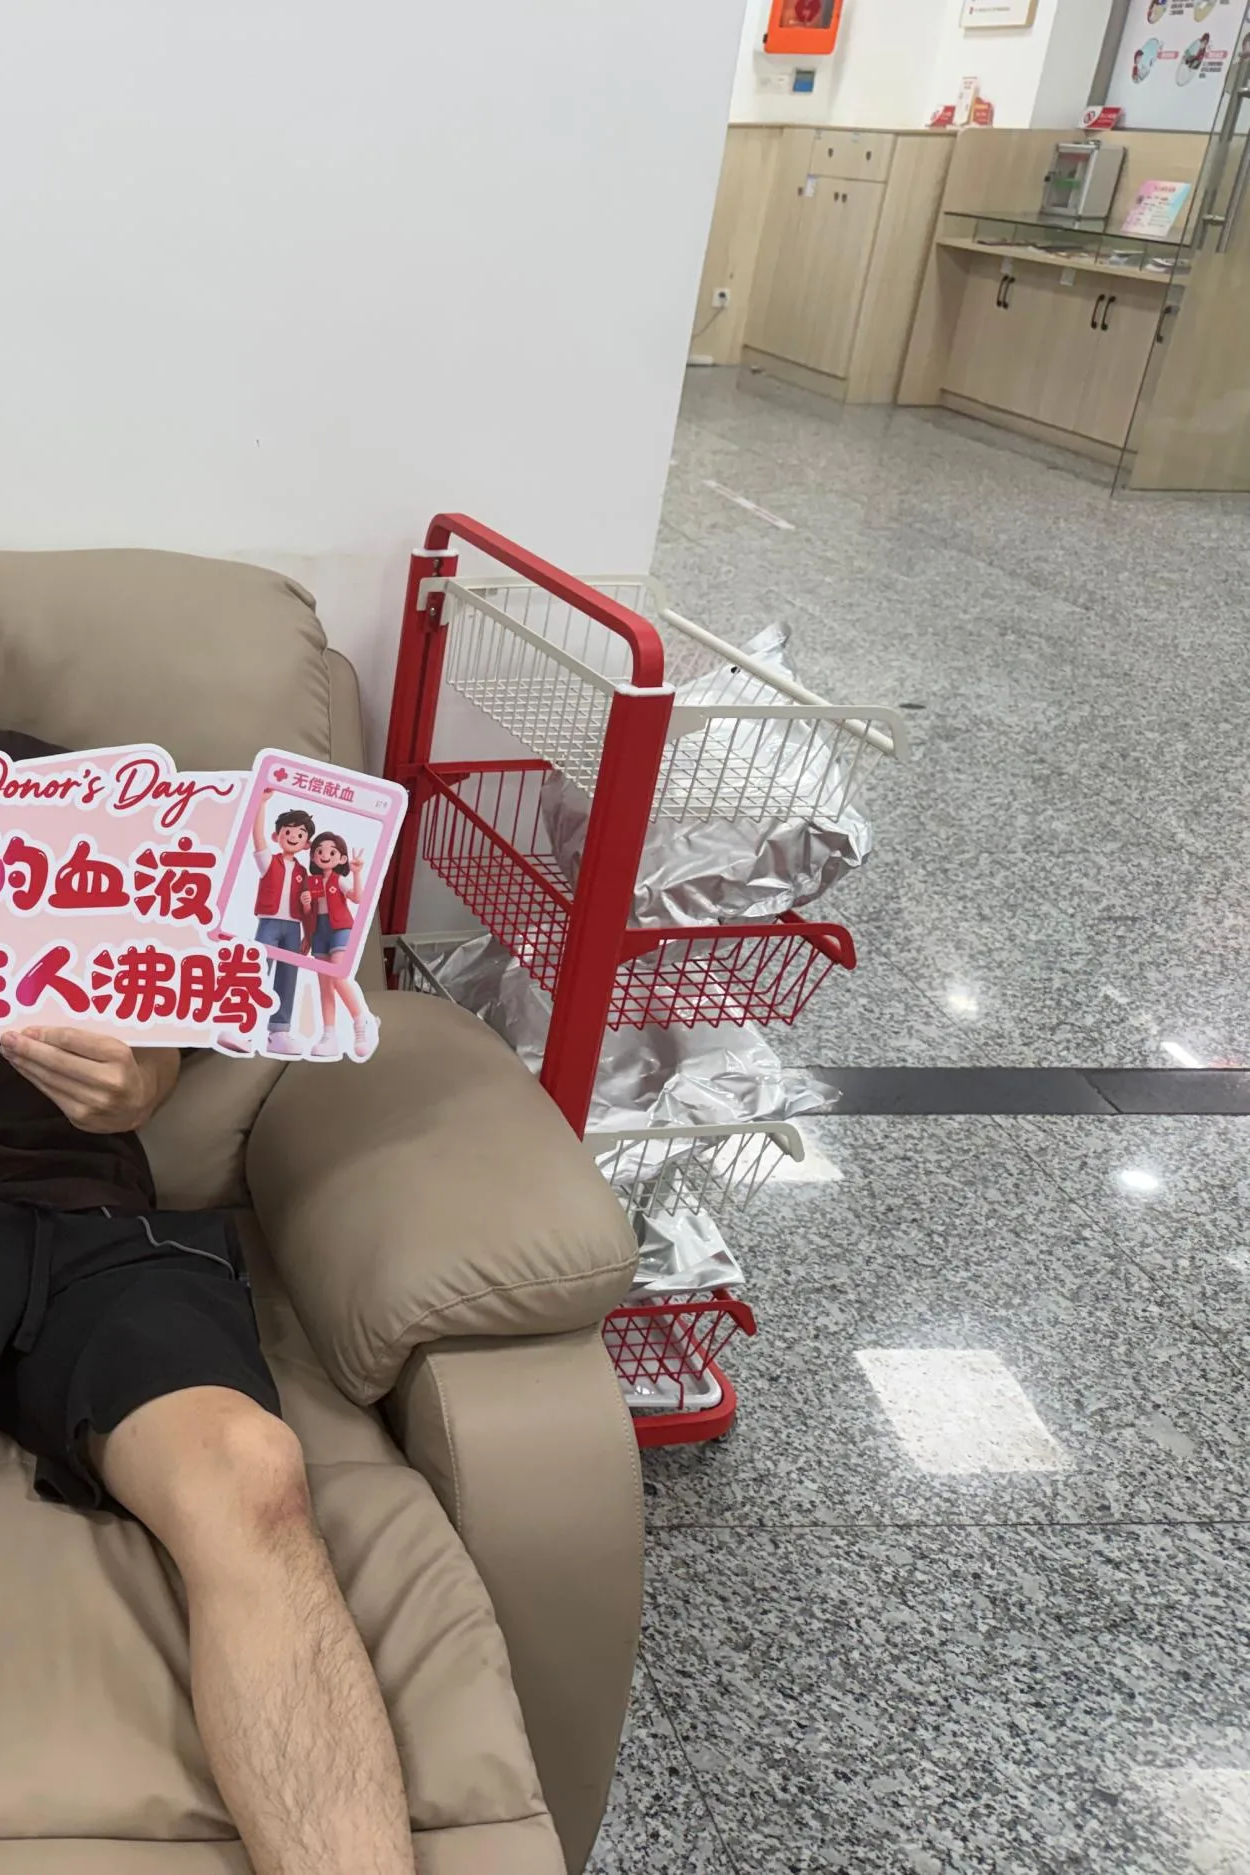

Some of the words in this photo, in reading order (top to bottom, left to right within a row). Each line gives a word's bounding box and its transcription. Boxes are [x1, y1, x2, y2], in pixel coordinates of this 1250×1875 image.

[113, 758, 234, 828] Day
[291, 772, 355, 803] 无偿献血
